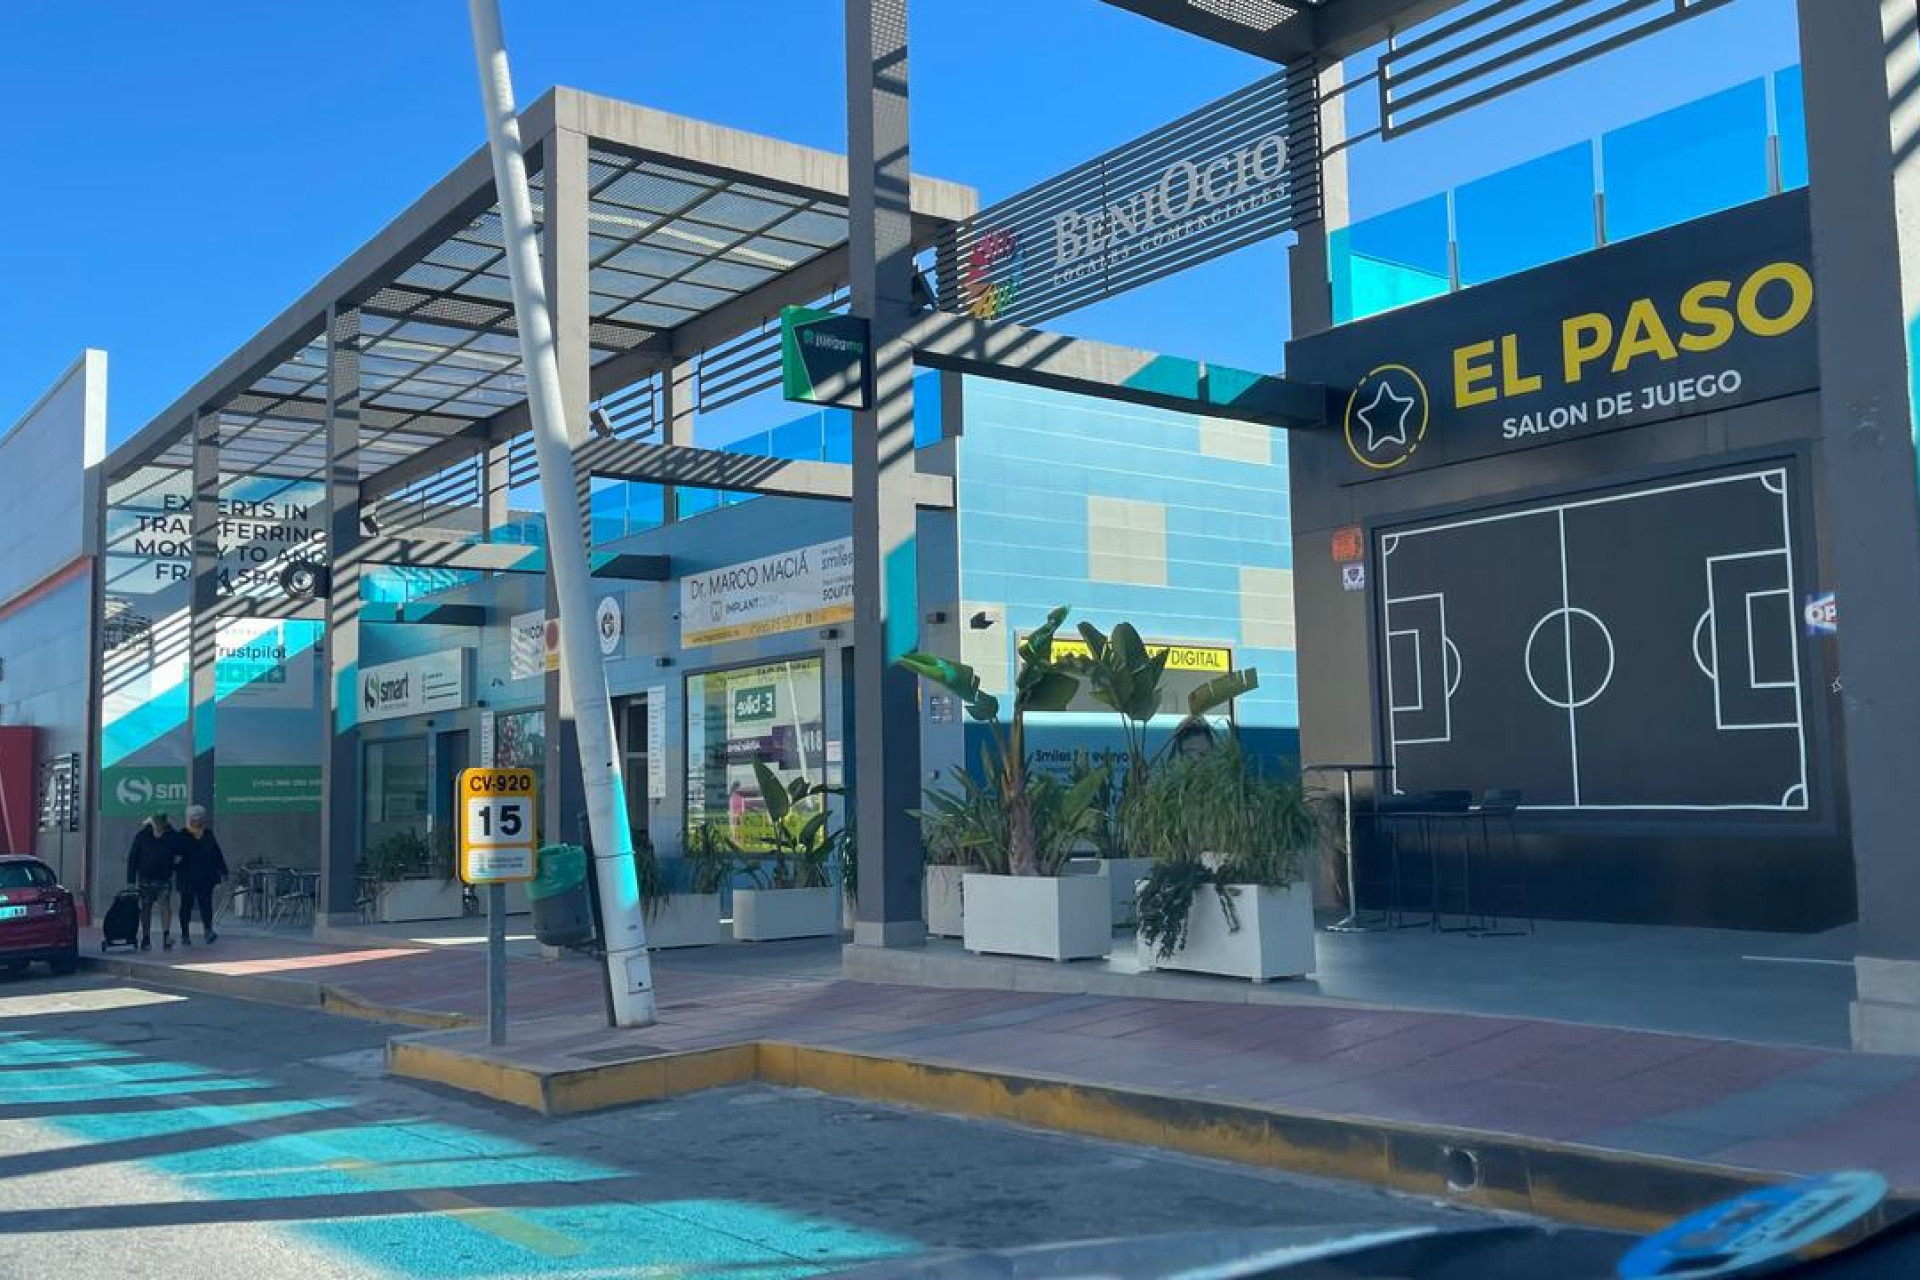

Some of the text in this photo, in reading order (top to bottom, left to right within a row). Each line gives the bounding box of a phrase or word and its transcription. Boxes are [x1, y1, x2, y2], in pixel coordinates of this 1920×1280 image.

[1454, 262, 1815, 409] EL PASO
[1502, 368, 1743, 440] SALON DE JUEGO
[163, 493, 308, 522] EXERTS IN
[135, 537, 229, 562] MONY
[235, 545, 268, 563] TO
[691, 548, 809, 600] Dr. MARCO MACIÁ
[1171, 649, 1221, 668] DIGITAL
[380, 671, 409, 703] smart
[469, 774, 531, 792] CV-920
[478, 804, 522, 836] 15
